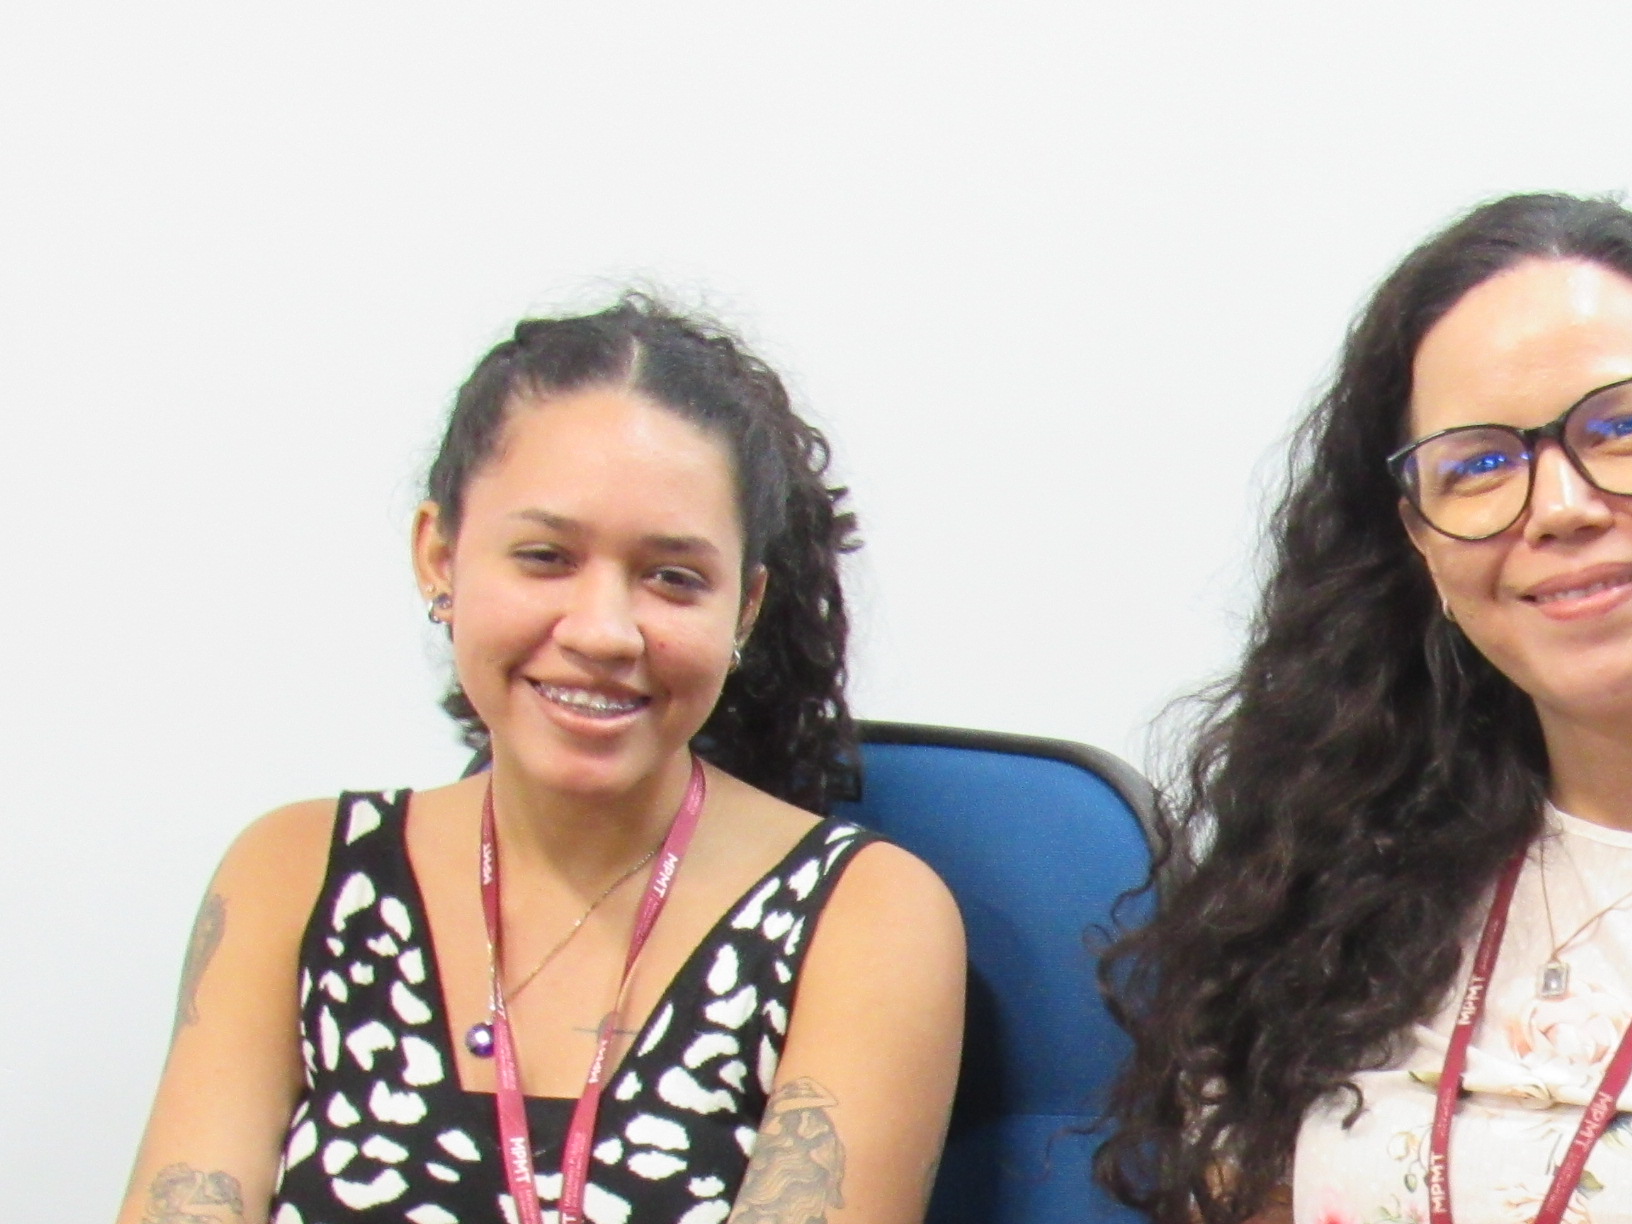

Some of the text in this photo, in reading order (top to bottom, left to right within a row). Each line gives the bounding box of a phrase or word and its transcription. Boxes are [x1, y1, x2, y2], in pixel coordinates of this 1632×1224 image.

[653, 852, 679, 899] MPMT
[1457, 974, 1486, 1026] MPMT
[1574, 1091, 1611, 1150] MPMT
[510, 1136, 531, 1184] MPMT
[1430, 1153, 1446, 1213] MPMT
